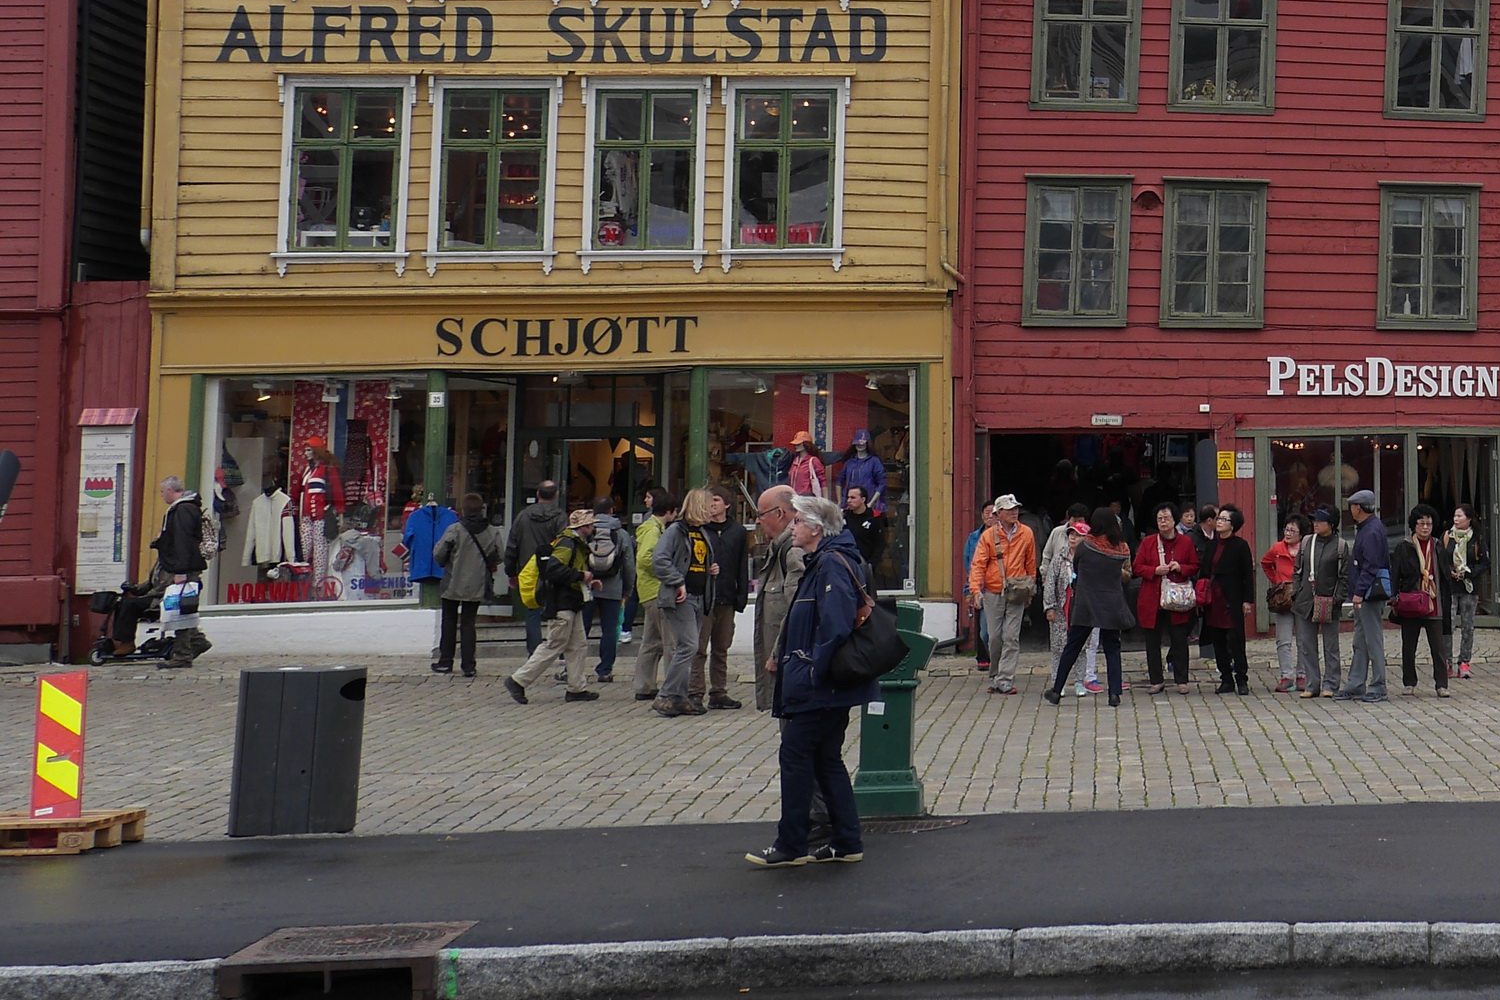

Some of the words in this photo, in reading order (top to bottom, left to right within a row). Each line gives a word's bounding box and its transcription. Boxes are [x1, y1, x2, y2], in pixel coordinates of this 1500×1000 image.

[215, 4, 494, 63] ALFRED
[546, 6, 888, 63] SKULSTAD
[435, 315, 699, 357] SCHJØTT
[227, 581, 311, 603] NORWAY
